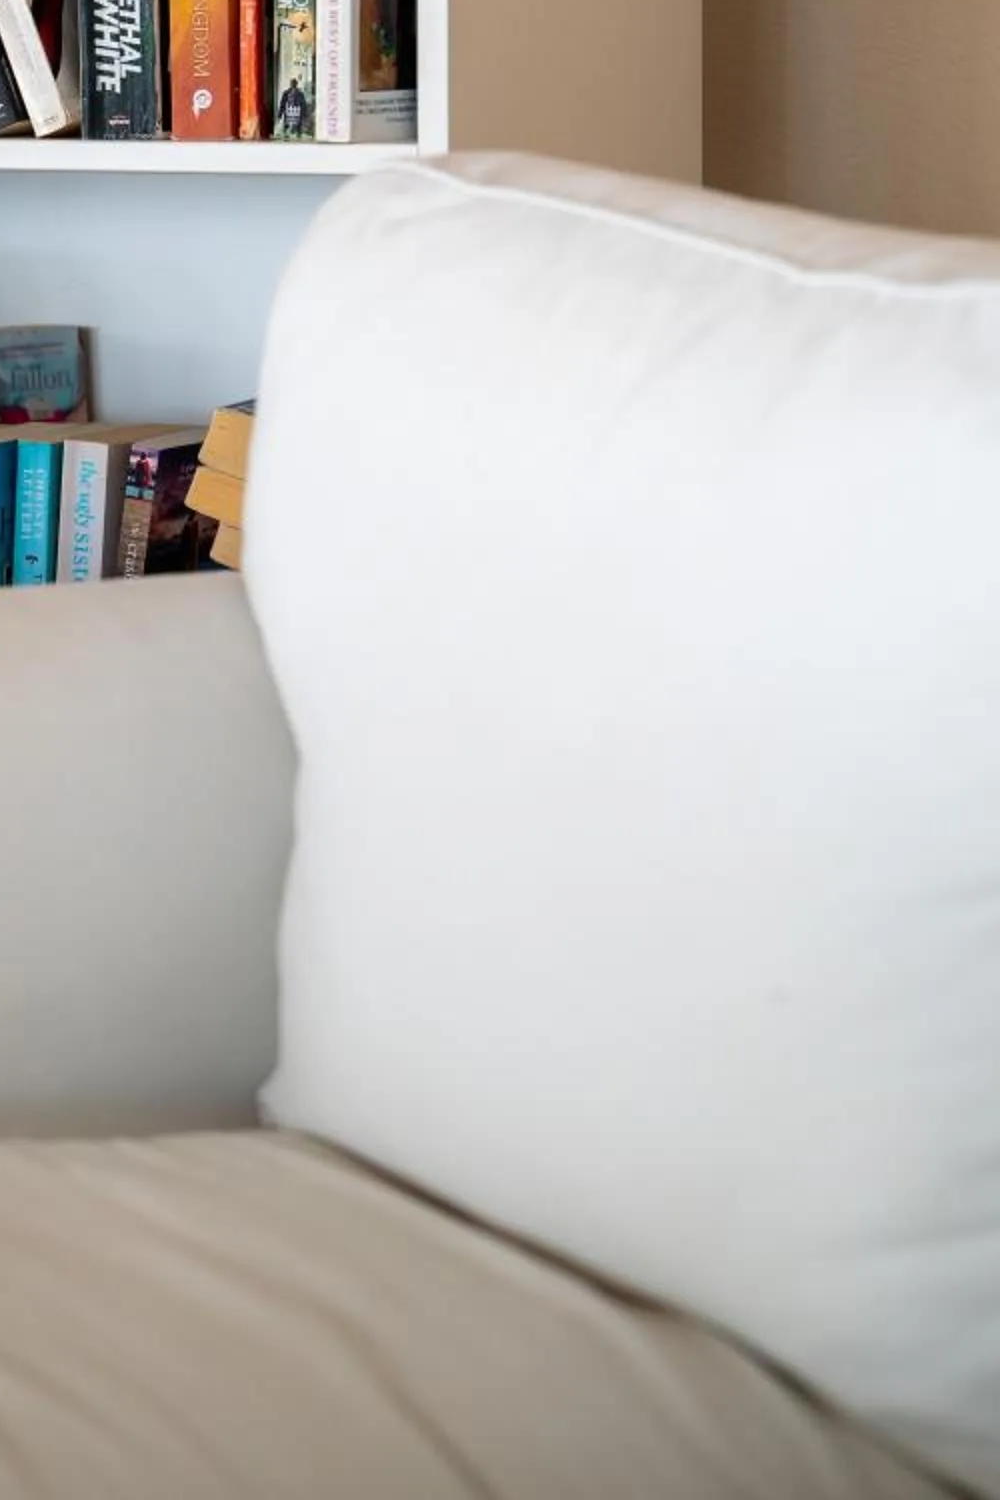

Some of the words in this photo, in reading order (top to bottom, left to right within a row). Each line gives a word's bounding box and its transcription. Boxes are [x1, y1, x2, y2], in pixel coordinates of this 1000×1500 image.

[80, 460, 99, 484] the
[74, 491, 96, 529] ugly
[71, 532, 93, 582] sist
